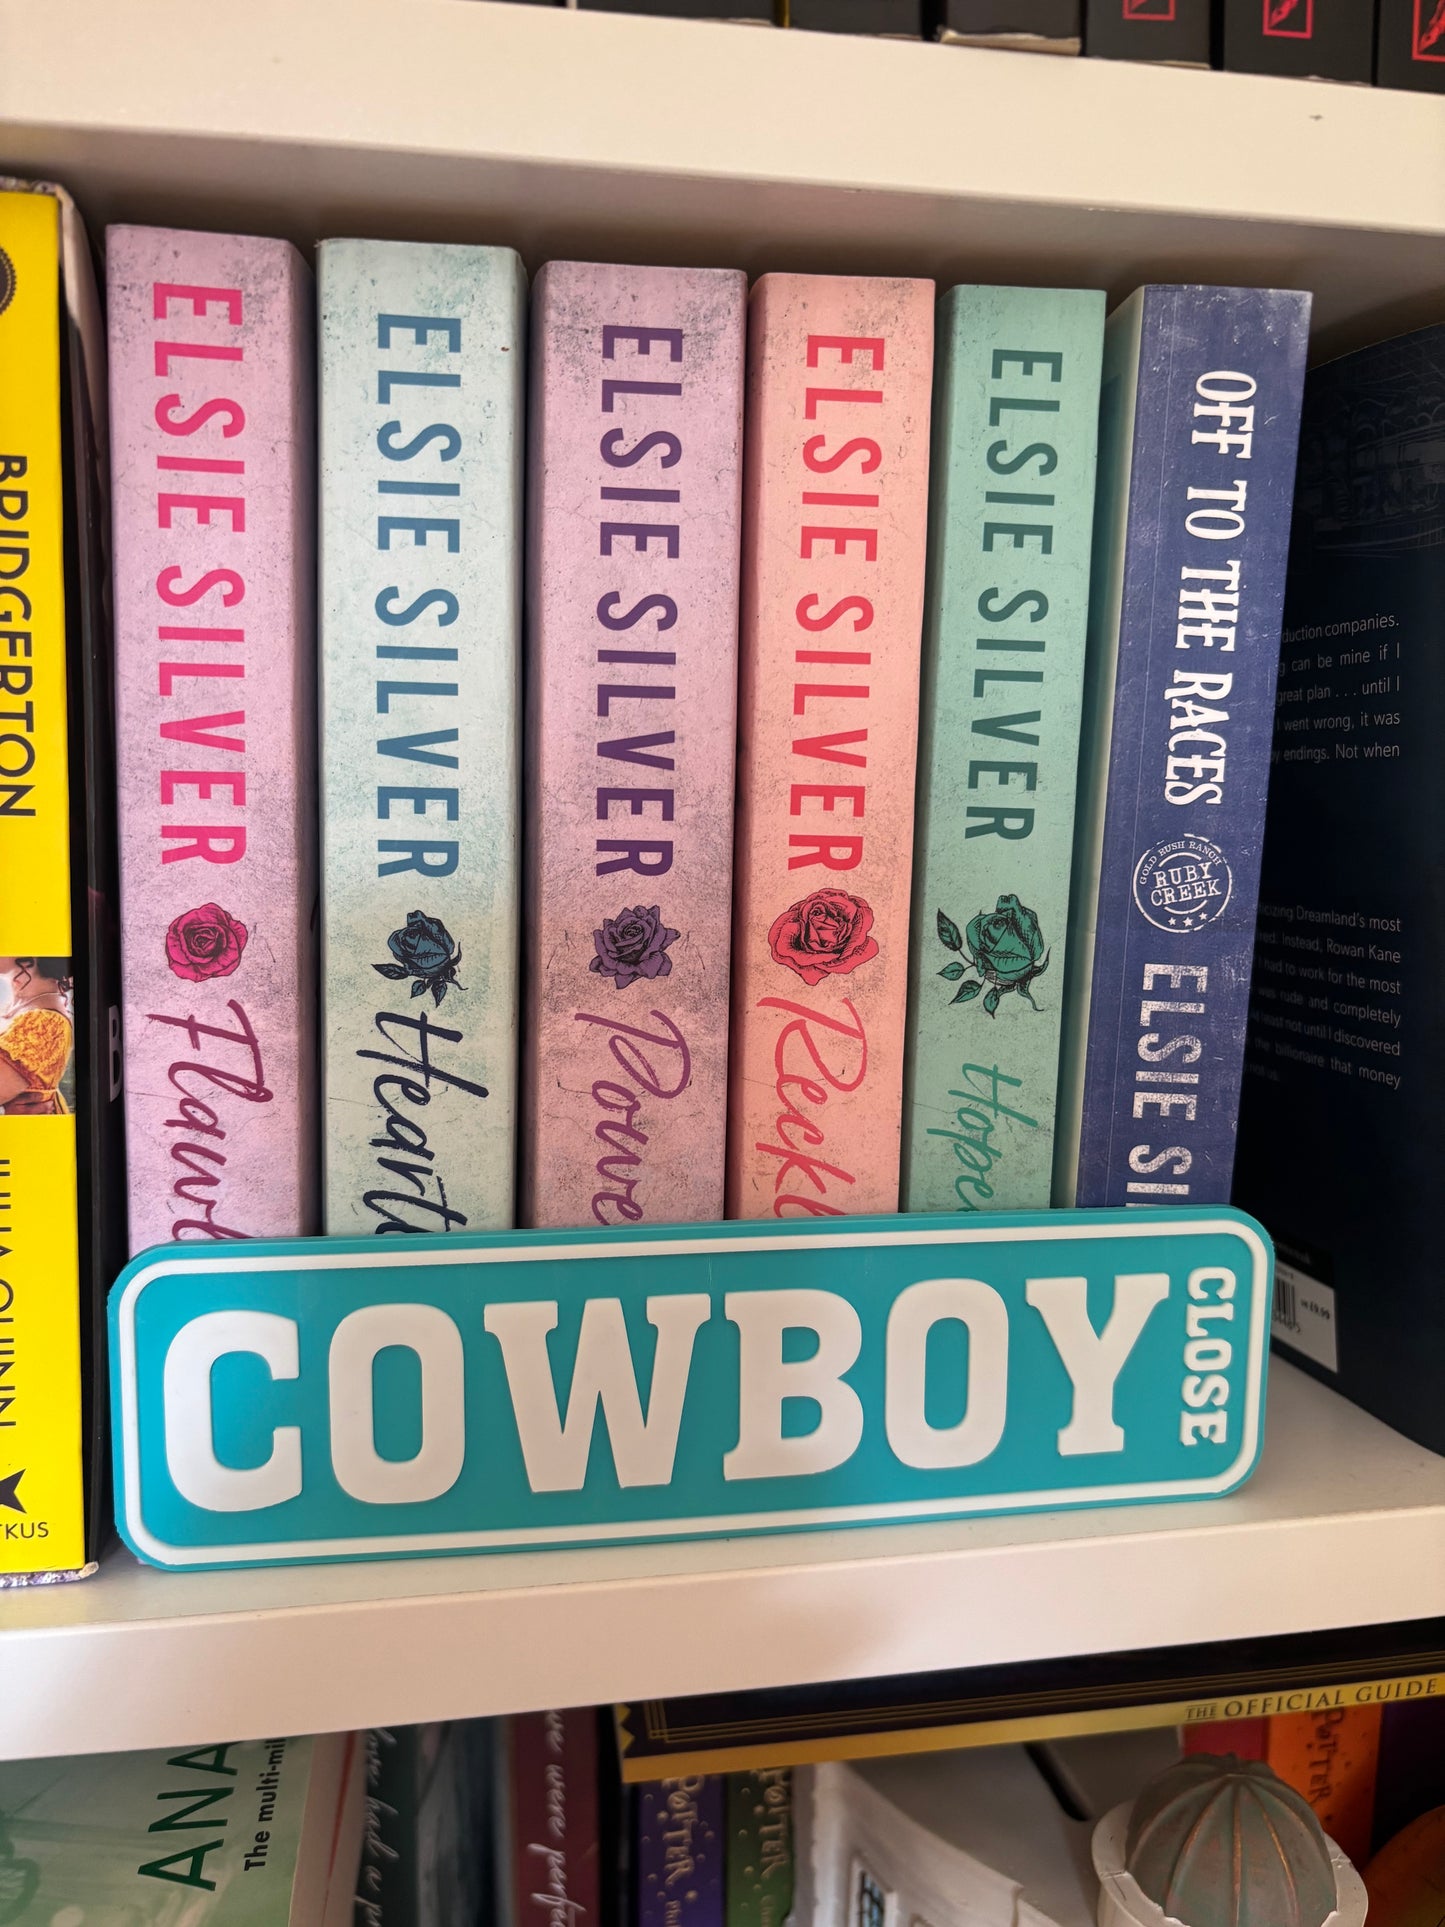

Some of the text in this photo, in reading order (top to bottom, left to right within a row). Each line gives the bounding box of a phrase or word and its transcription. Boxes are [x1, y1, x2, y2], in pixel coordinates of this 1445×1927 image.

[153, 282, 247, 865] ELSIE SILVER
[1163, 370, 1257, 806] OFF TO THE RACES
[375, 313, 462, 878] ELSIE SILVER
[595, 325, 683, 877] ELSIE SILVER
[788, 335, 885, 872] ELSIE SILVER
[965, 348, 1063, 841] ELSIE SILVER
[1324, 613, 1399, 636] companies.
[1292, 658, 1310, 672] can
[1317, 653, 1332, 668] be
[1340, 649, 1370, 666] mine
[1379, 643, 1388, 661] if
[1307, 684, 1330, 703] plan
[1362, 677, 1390, 695] until
[1284, 716, 1309, 731] went
[1314, 717, 1355, 732] wrong,
[1360, 711, 1369, 727] it
[1373, 712, 1400, 726] was
[1283, 746, 1330, 764] endings.
[1335, 743, 1358, 759] Not
[1363, 742, 1400, 759] when
[1140, 841, 1222, 885] GOLD RUSH RANCH
[1153, 862, 1213, 889] RUBY
[1151, 879, 1222, 906] CREEK
[1297, 905, 1365, 928] Dreamland's
[1369, 917, 1401, 933] most
[1327, 938, 1365, 958] Rowan
[1368, 944, 1401, 964] Kane
[1299, 965, 1324, 981] work
[1328, 968, 1343, 985] for
[1347, 971, 1366, 989] the
[1369, 979, 1401, 995] most
[1333, 1001, 1401, 1029] completely
[1334, 1028, 1401, 1056] discovered
[1126, 963, 1209, 1207] ELSIE SI
[1330, 1057, 1352, 1075] that
[1358, 1065, 1401, 1090] money
[356, 1011, 490, 1234] Heart
[1180, 1266, 1237, 1447] CLOSE
[164, 1274, 1170, 1512] COWBOY
[1185, 1678, 1438, 1721] THE OFFICIAL GUIDE
[244, 1830, 270, 1871] The
